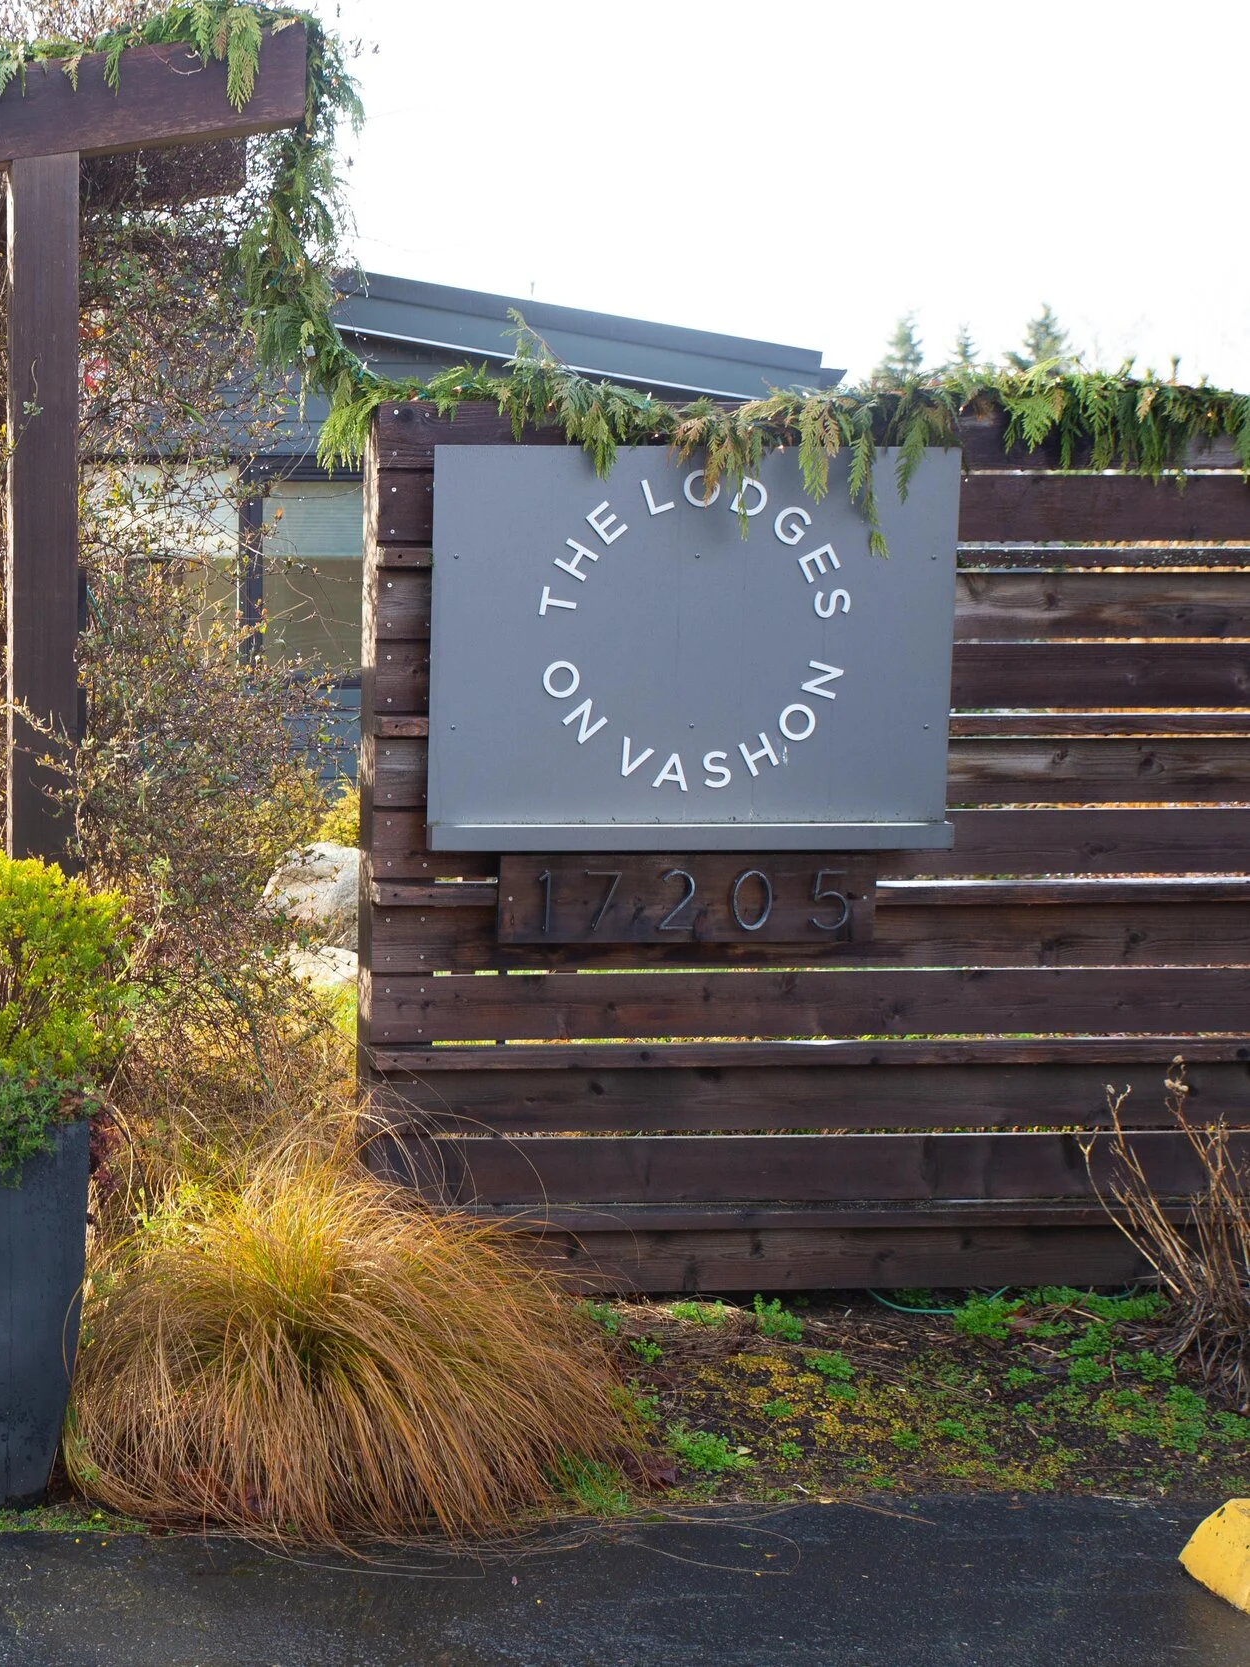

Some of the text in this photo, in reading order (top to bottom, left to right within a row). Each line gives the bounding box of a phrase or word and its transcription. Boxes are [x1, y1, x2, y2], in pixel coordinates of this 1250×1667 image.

[538, 468, 852, 620] THE LODGES
[542, 659, 845, 792] ON VASHON
[537, 867, 850, 933] 17205
